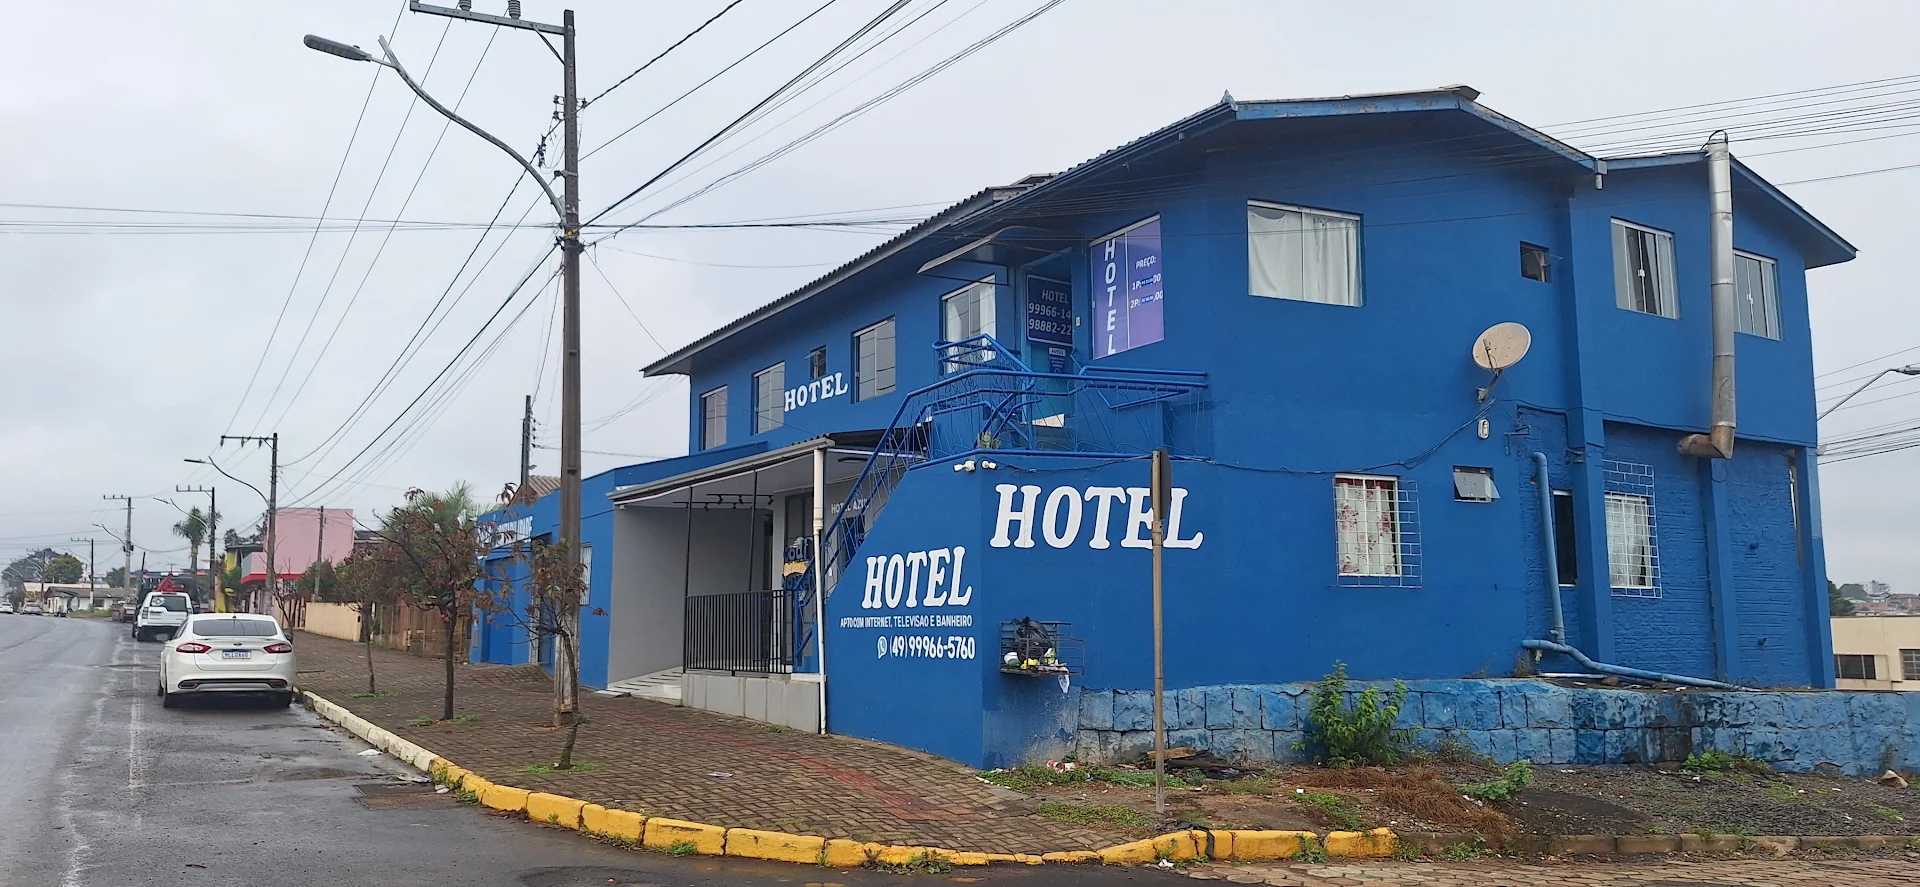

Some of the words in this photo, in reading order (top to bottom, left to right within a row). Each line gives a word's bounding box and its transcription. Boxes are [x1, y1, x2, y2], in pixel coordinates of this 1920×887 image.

[1041, 289, 1070, 304] HOTEL
[1104, 238, 1117, 355] HOTEL
[784, 372, 849, 412] HOTEL
[831, 501, 852, 514] HOTL
[989, 484, 1204, 550] HOTEL
[861, 546, 973, 609] HOTEL
[930, 615, 936, 627] E
[936, 614, 973, 627] BANHEIRO
